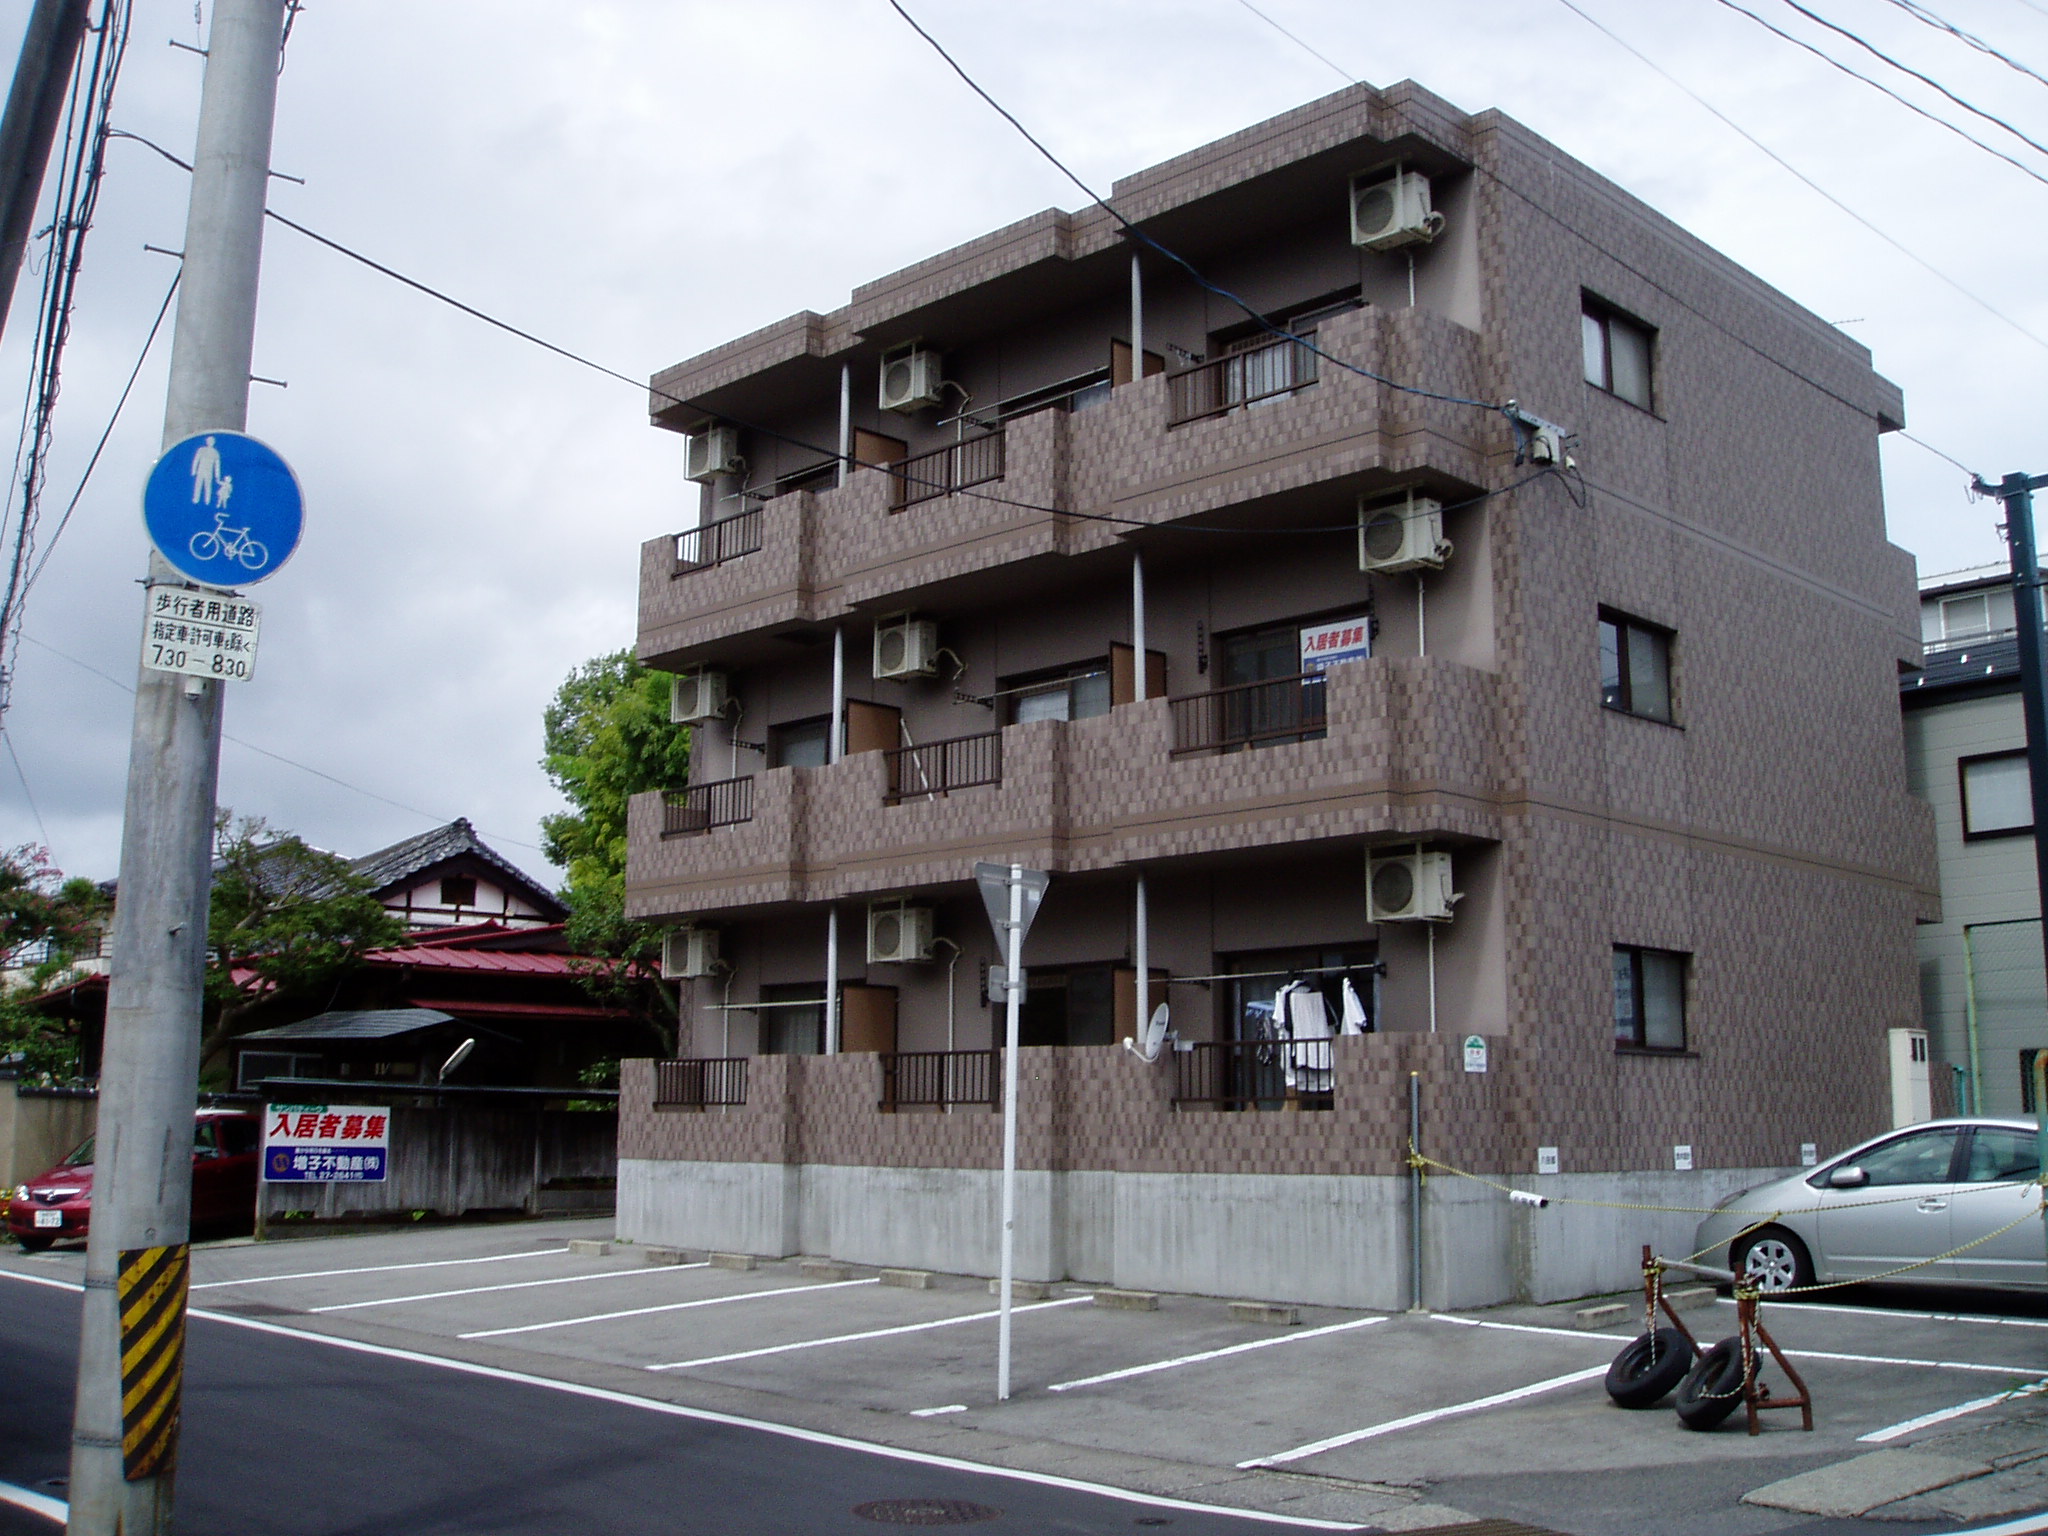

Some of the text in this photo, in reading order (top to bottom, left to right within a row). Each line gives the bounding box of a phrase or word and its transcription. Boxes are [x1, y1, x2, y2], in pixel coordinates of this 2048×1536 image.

[156, 593, 255, 627] 歩行者用道路
[270, 1113, 387, 1139] 入居者募集
